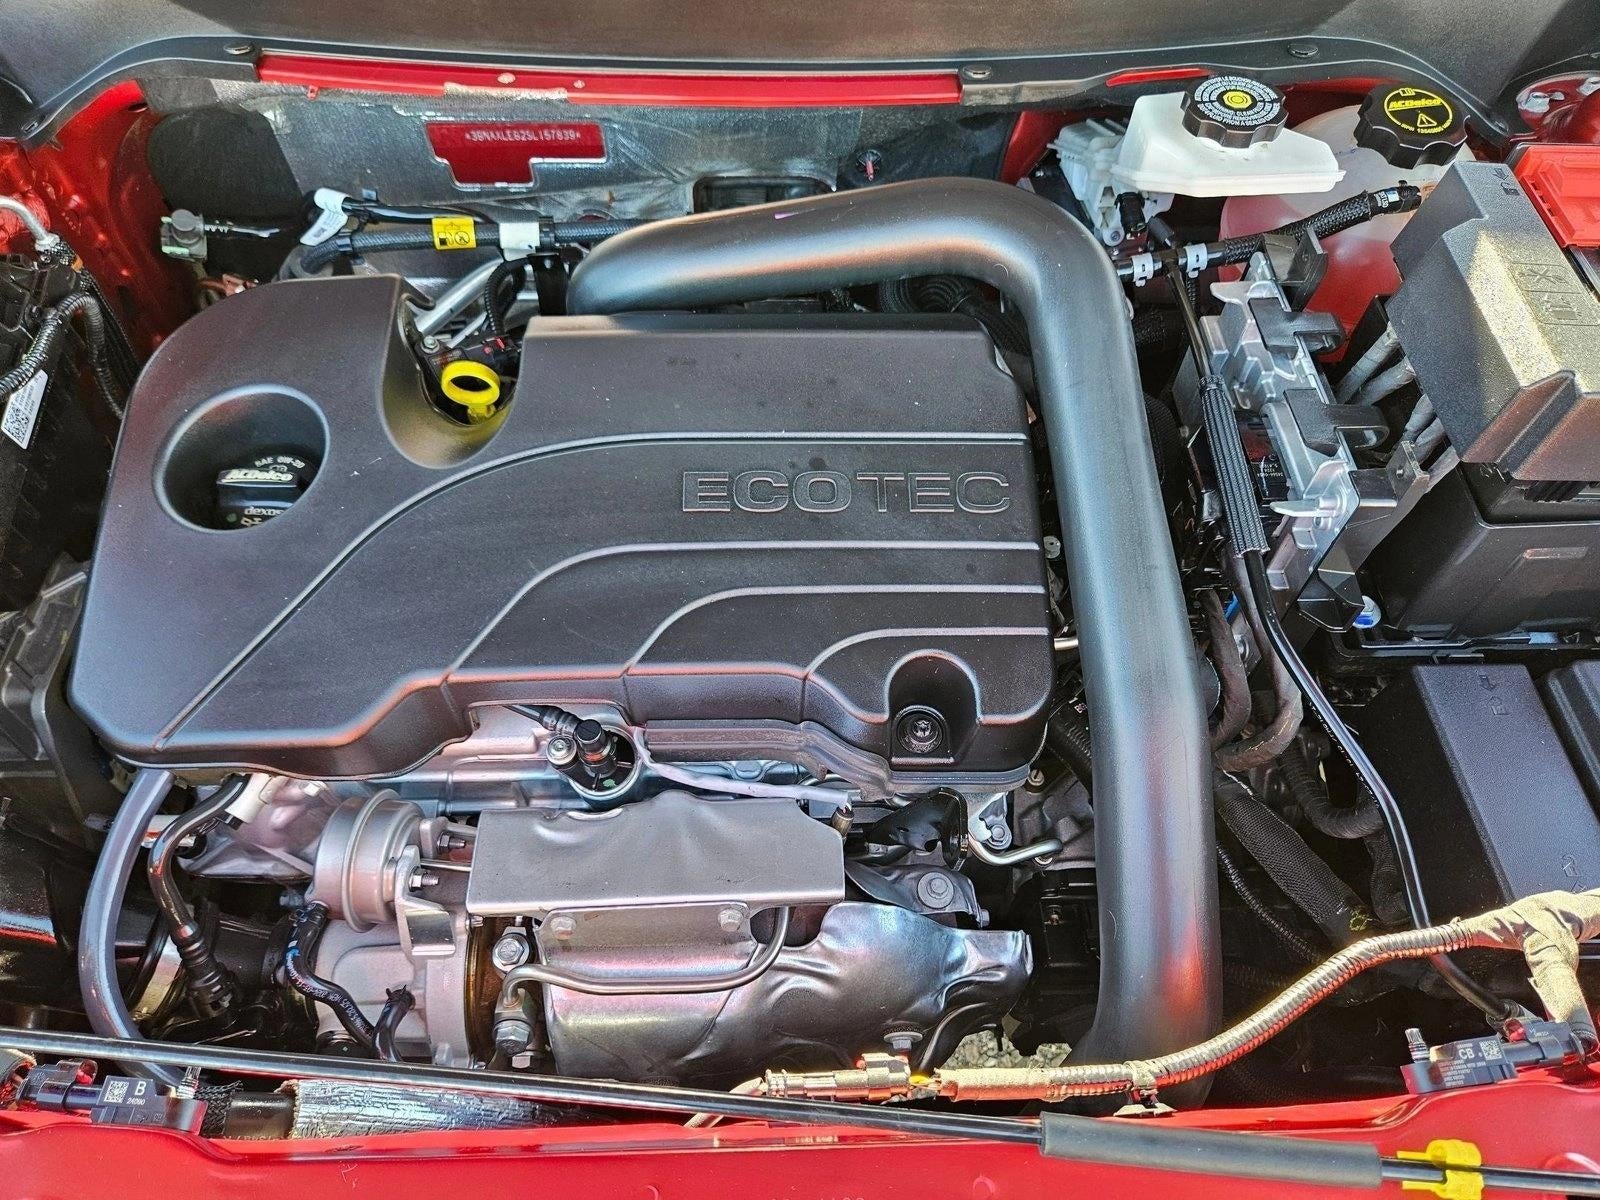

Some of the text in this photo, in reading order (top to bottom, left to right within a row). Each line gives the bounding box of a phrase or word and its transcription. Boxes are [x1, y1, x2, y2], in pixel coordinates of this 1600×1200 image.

[682, 470, 1010, 514] ECOTEC
[1458, 1048, 1475, 1060] CB
[134, 1080, 147, 1096] B
